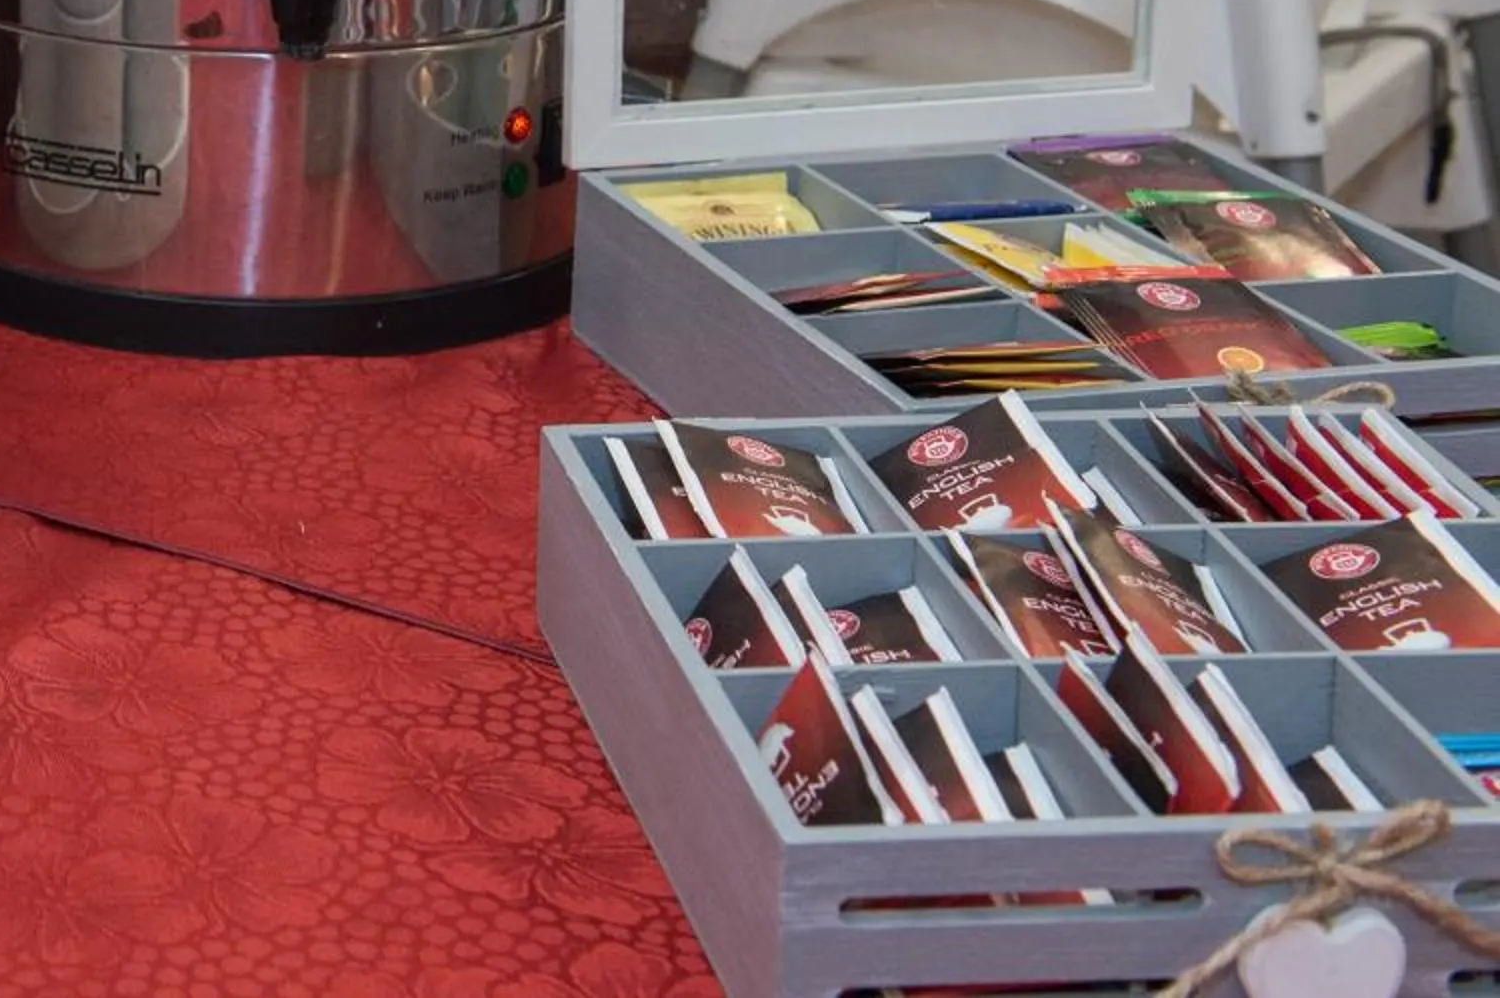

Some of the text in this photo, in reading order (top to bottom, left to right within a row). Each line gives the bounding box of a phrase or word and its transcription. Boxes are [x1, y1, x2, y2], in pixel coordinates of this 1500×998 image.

[907, 454, 1016, 510] ENGLISH
[939, 475, 995, 501] TEA
[754, 485, 809, 506] TEA
[1318, 579, 1444, 628] ENGLISH
[1356, 596, 1422, 622] TEA
[1059, 616, 1100, 634] TE
